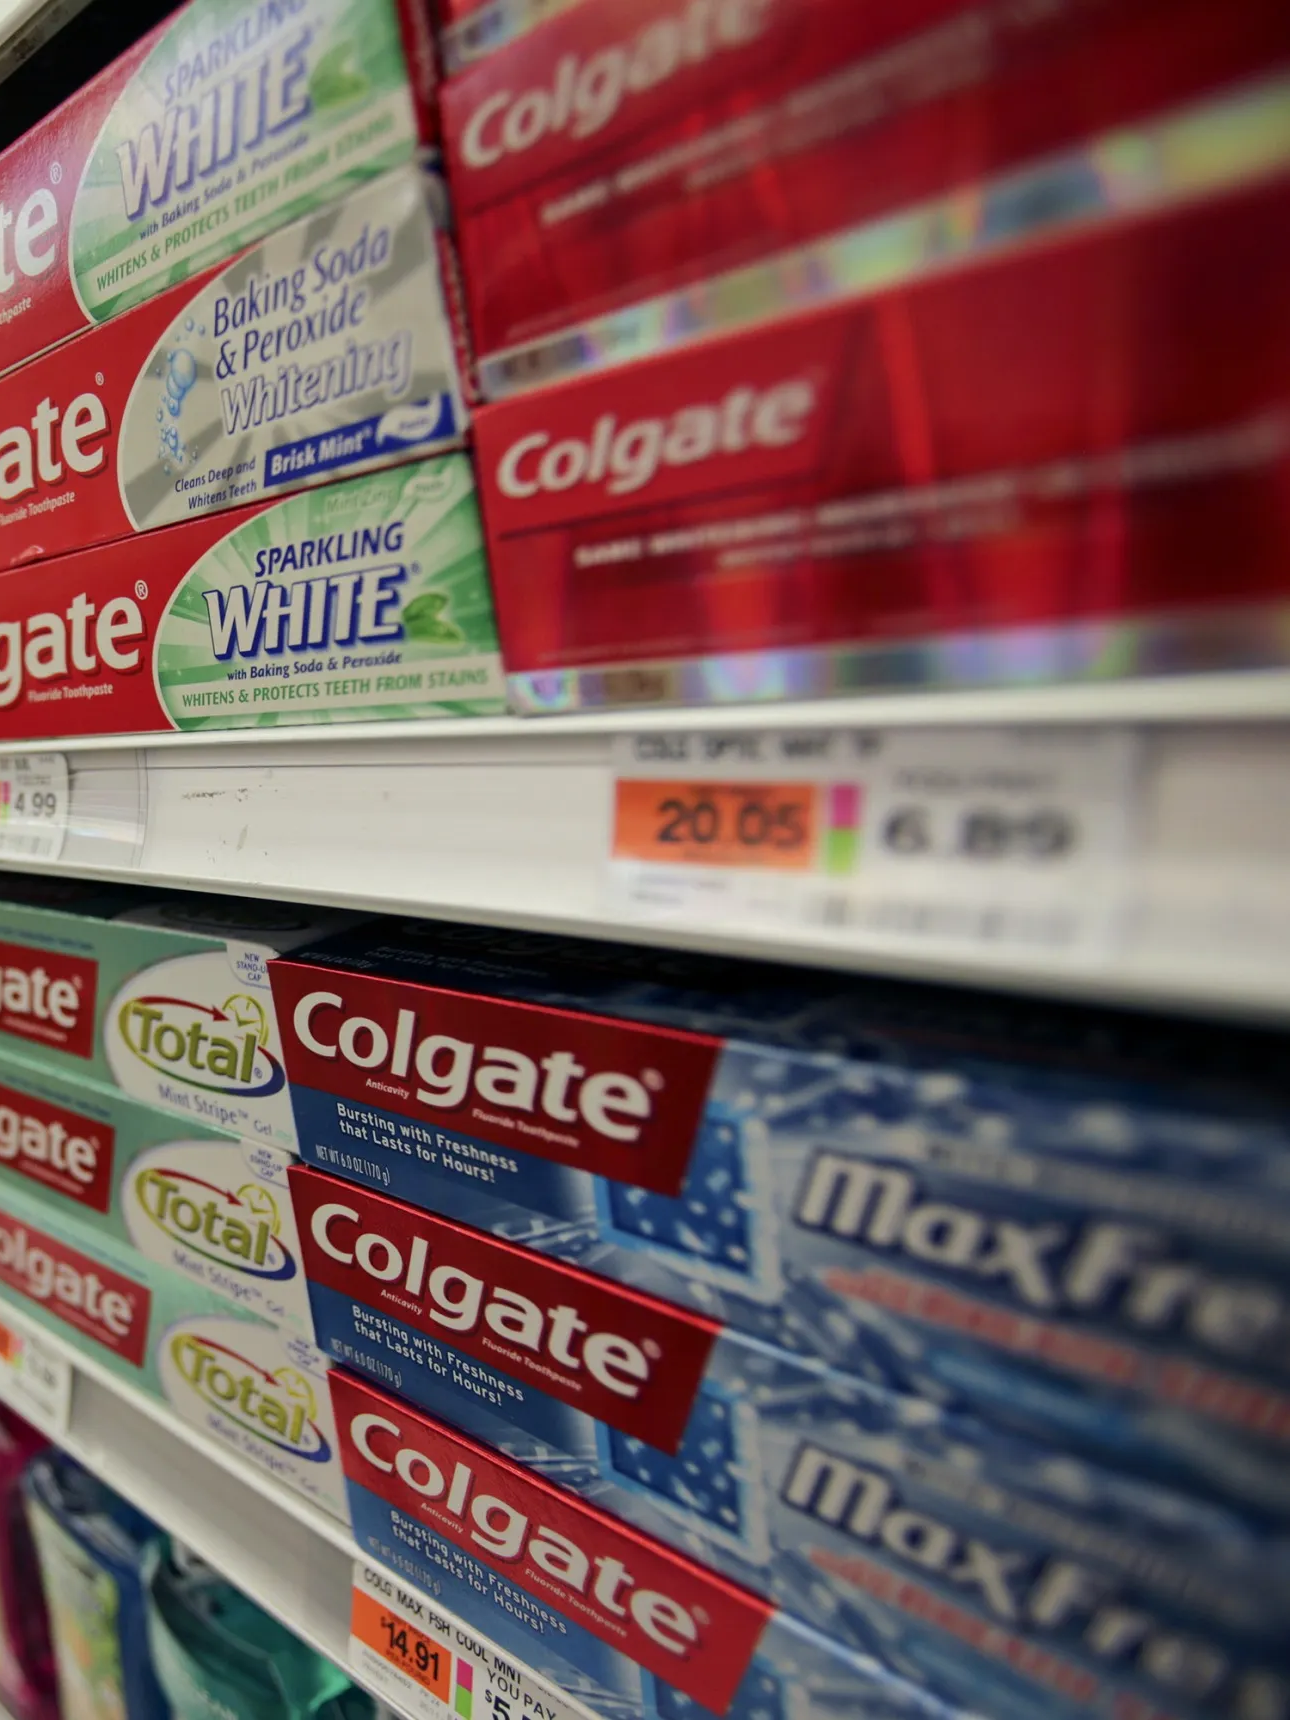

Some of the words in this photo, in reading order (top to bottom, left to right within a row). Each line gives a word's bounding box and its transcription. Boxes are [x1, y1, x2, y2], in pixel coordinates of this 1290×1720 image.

[115, 28, 315, 222] WHITE
[96, 251, 148, 291] WHITENS
[150, 242, 161, 259] &
[164, 206, 230, 254] PROTECTS
[233, 178, 280, 217] TEETH
[139, 222, 159, 240] with
[161, 196, 200, 226] Baking
[203, 179, 233, 203] Soda
[214, 266, 306, 338] Baking
[312, 222, 391, 293] Soda
[215, 340, 237, 380] &
[242, 284, 369, 371] Peroxide
[219, 331, 413, 437] Whitening
[270, 443, 316, 477] Brisk
[318, 431, 364, 463] Mint
[497, 378, 815, 498] Colgate
[28, 491, 75, 519] Toothpaste
[175, 471, 206, 493] Cleans
[208, 464, 235, 488] Deep
[236, 456, 256, 476] and
[188, 489, 227, 510] Whitens
[229, 479, 257, 497] Teeth
[255, 521, 405, 578] SPARKLING
[202, 563, 407, 661] WHITE
[63, 682, 113, 700] Toothpaste
[182, 690, 235, 708] WHITENS
[239, 689, 249, 703] &
[253, 682, 319, 701] PROTECTS
[325, 678, 370, 695] TEETH
[376, 674, 422, 690] FROM
[227, 668, 247, 681] with
[250, 665, 290, 680] Baking
[293, 659, 323, 673] Soda
[327, 658, 338, 671] &
[343, 651, 401, 668] Peroxide
[236, 961, 268, 974] STAND-U
[245, 953, 260, 963] NEW
[247, 972, 262, 982] CAP
[132, 1002, 258, 1084] Total
[292, 991, 652, 1142] Colgate
[158, 1083, 191, 1109] Mint
[365, 1078, 410, 1100] Anticavity
[315, 1144, 328, 1162] NET
[328, 1148, 340, 1165] WT
[353, 1156, 364, 1174] OZ
[336, 1102, 395, 1135] Bursting
[400, 1125, 431, 1145] with
[436, 1133, 519, 1173] Freshness
[339, 1120, 368, 1141] that
[373, 1132, 412, 1155] Lasts
[415, 1144, 437, 1163] for
[442, 1154, 496, 1183] Hours!
[148, 1175, 271, 1267] Total
[310, 1202, 650, 1399] Colgate
[380, 1289, 424, 1316] Anticavity
[351, 1304, 408, 1345] Bursting
[412, 1333, 443, 1360] with
[447, 1350, 525, 1402] Freshness
[354, 1320, 382, 1344] that
[386, 1334, 424, 1365] Lasts
[427, 1355, 447, 1377] for
[452, 1370, 503, 1407] Hours!
[185, 1341, 308, 1445] Total
[349, 1412, 698, 1656] Colgate
[420, 1502, 464, 1534] Anticavity
[389, 1510, 448, 1558] Bursting
[452, 1549, 484, 1579] with
[488, 1571, 568, 1635] Freshness
[392, 1525, 421, 1552] that
[425, 1546, 464, 1580] Lasts
[467, 1572, 488, 1595] for
[492, 1590, 546, 1634] Hours!
[524, 1568, 566, 1599] Fluoride
[363, 1567, 392, 1598] COLG
[397, 1589, 424, 1620] MAX
[455, 1630, 489, 1664] COOL
[486, 1667, 520, 1701] YOU
[523, 1692, 557, 1720] PAY
